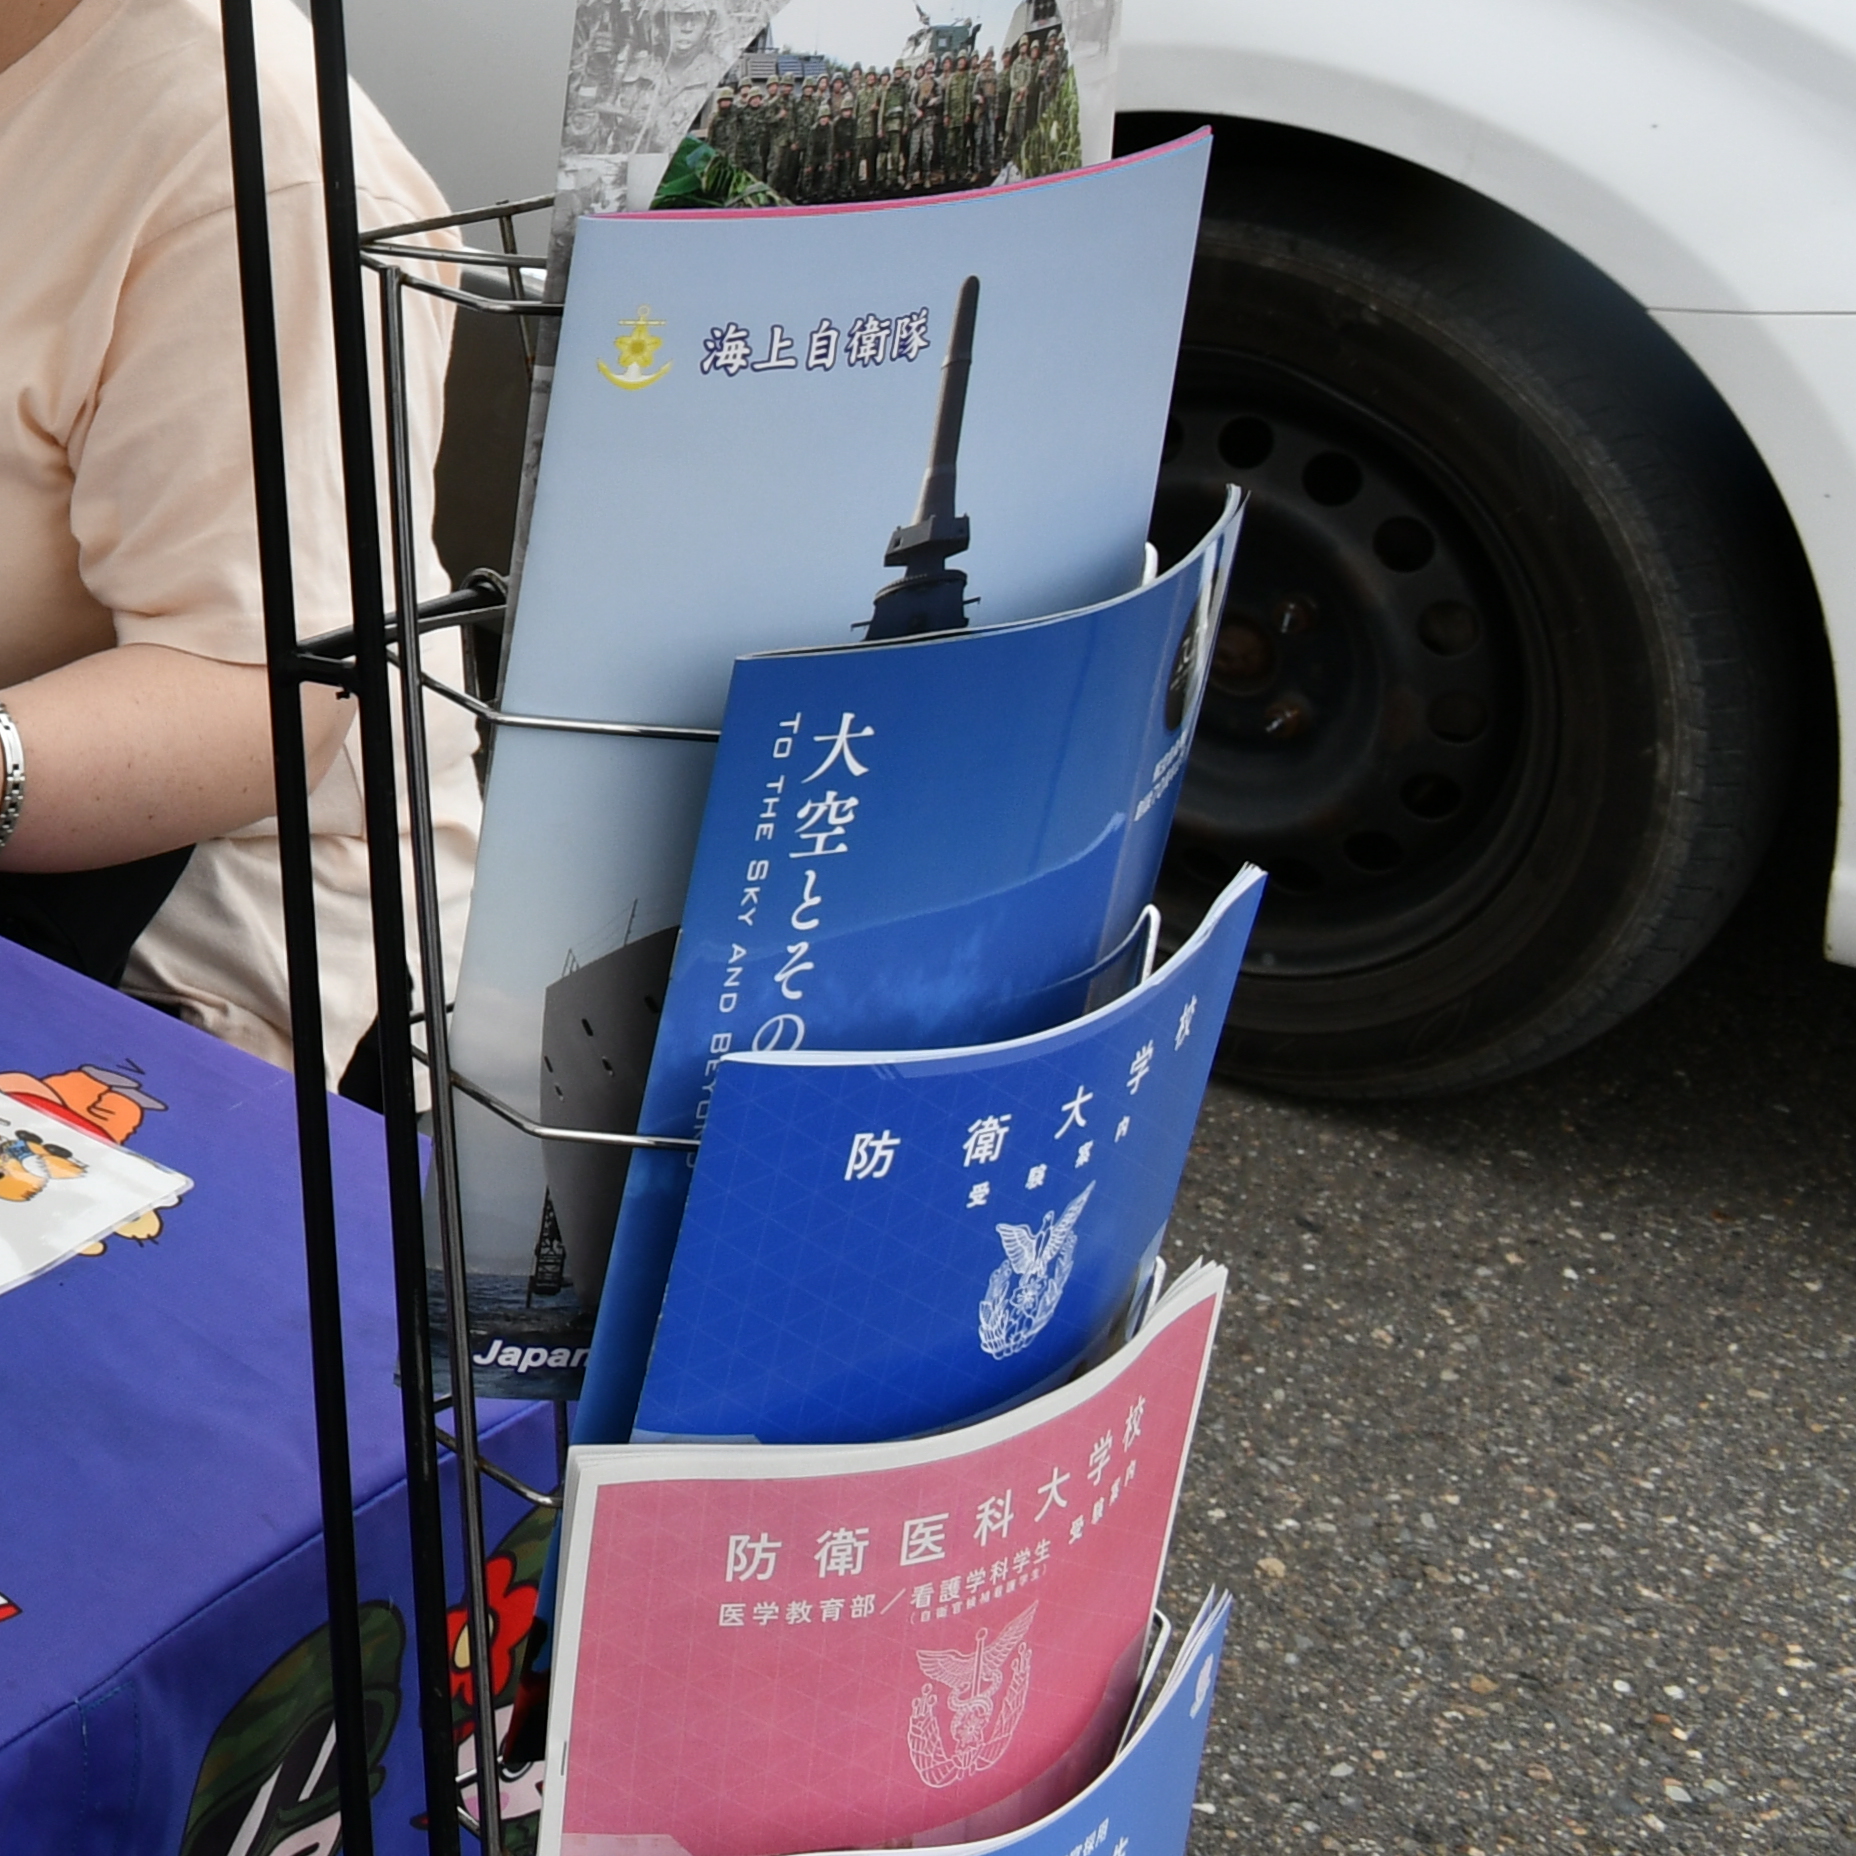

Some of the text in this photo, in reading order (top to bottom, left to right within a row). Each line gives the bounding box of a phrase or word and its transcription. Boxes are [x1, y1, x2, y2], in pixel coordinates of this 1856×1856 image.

[699, 307, 931, 378] 海上自衛隊
[772, 711, 802, 759] TO
[754, 775, 786, 841] THE
[736, 858, 770, 927] SKY
[750, 711, 876, 1053] 大空とその
[718, 943, 748, 1014] AND
[844, 994, 1198, 1181] 防衛大学校
[725, 1394, 1149, 1583] 防衛医科大学校
